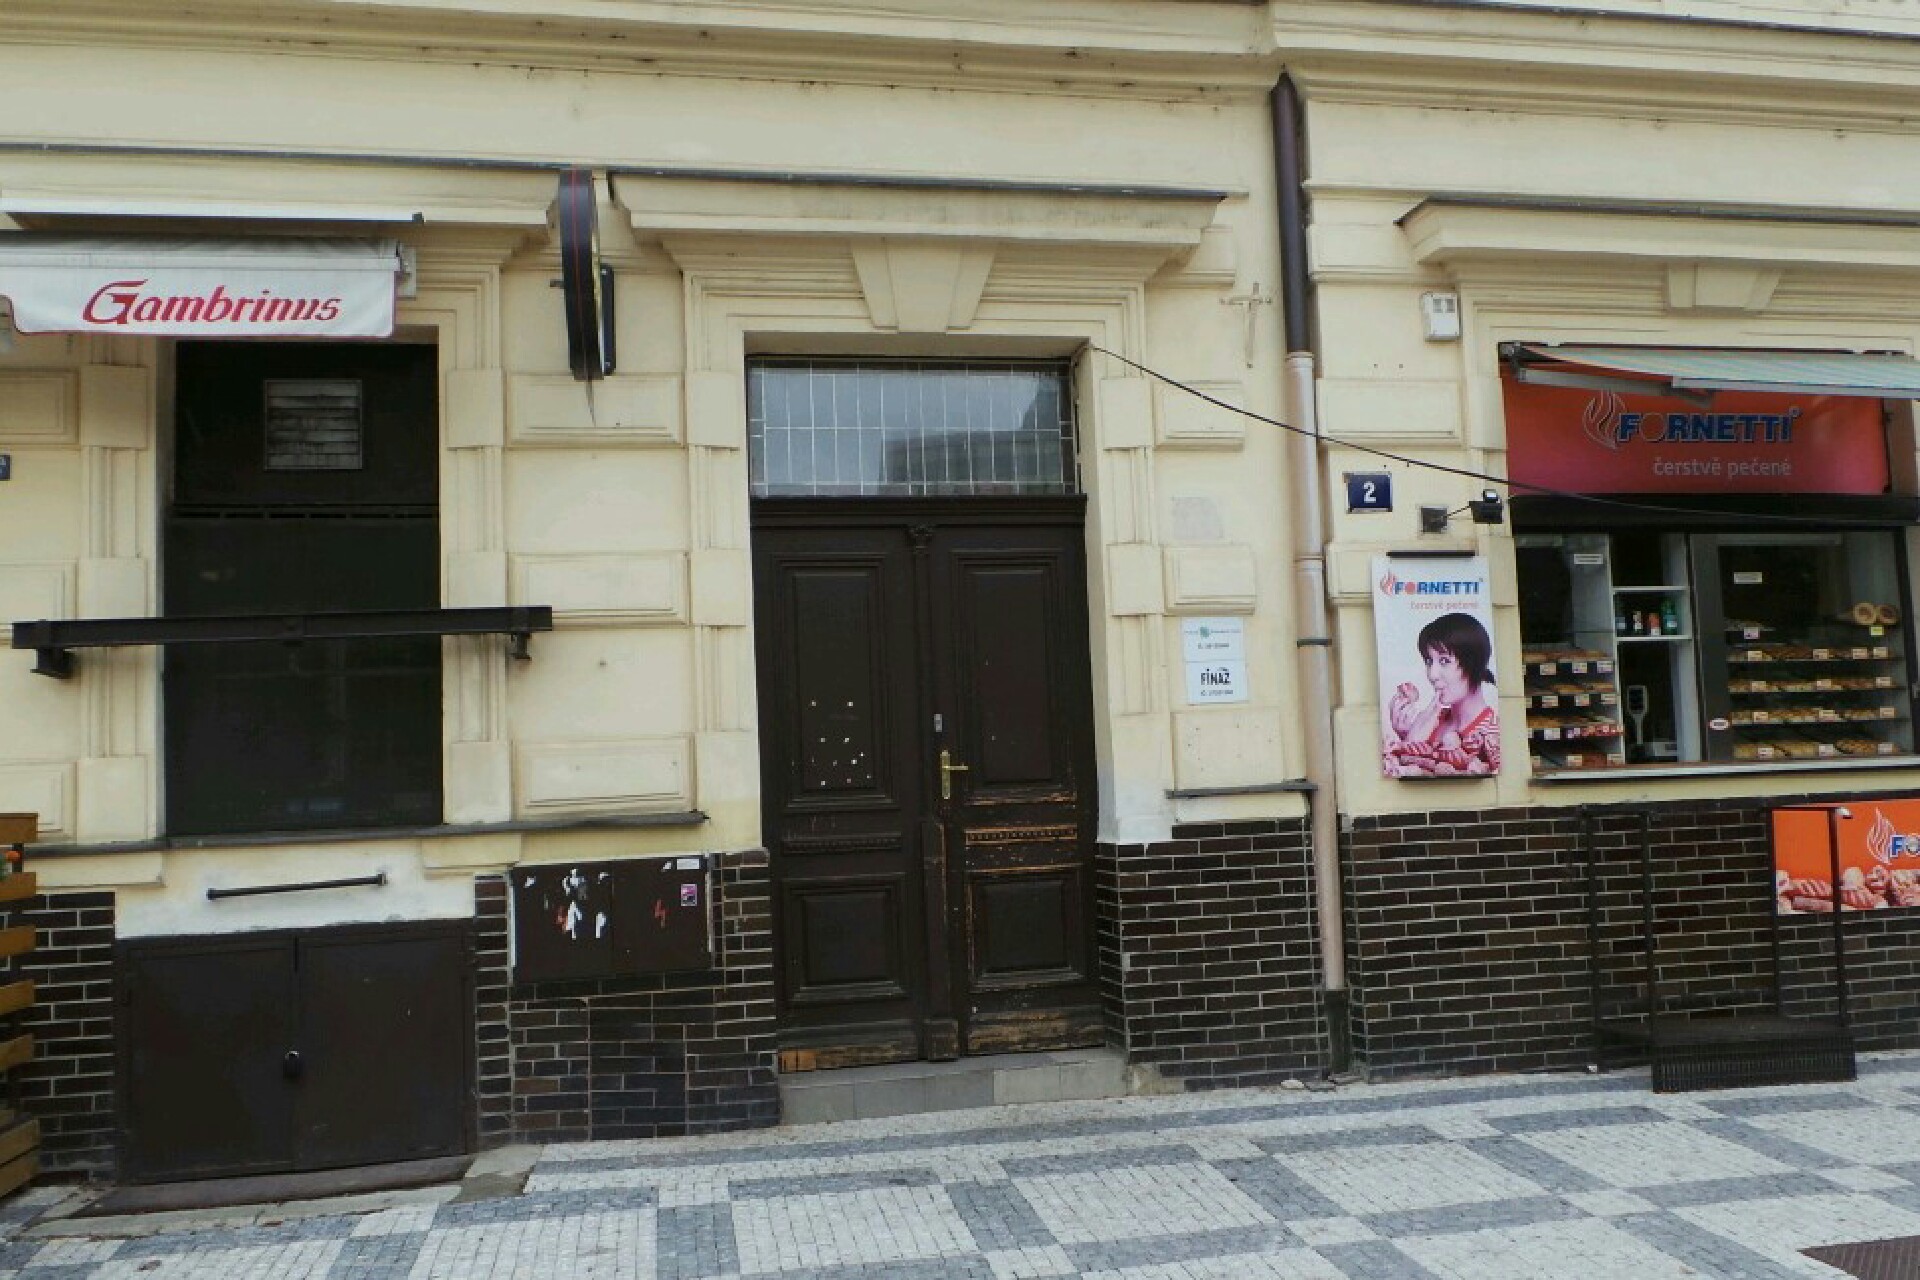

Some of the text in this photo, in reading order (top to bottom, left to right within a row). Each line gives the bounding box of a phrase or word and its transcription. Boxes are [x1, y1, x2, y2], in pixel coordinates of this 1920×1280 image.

[82, 278, 342, 325] Gambrinus
[1617, 412, 1793, 443] FORNETTI
[1727, 457, 1792, 480] pečené
[1363, 480, 1377, 504] 2
[1394, 581, 1480, 595] FORNETTI
[1889, 833, 1920, 858] FO
